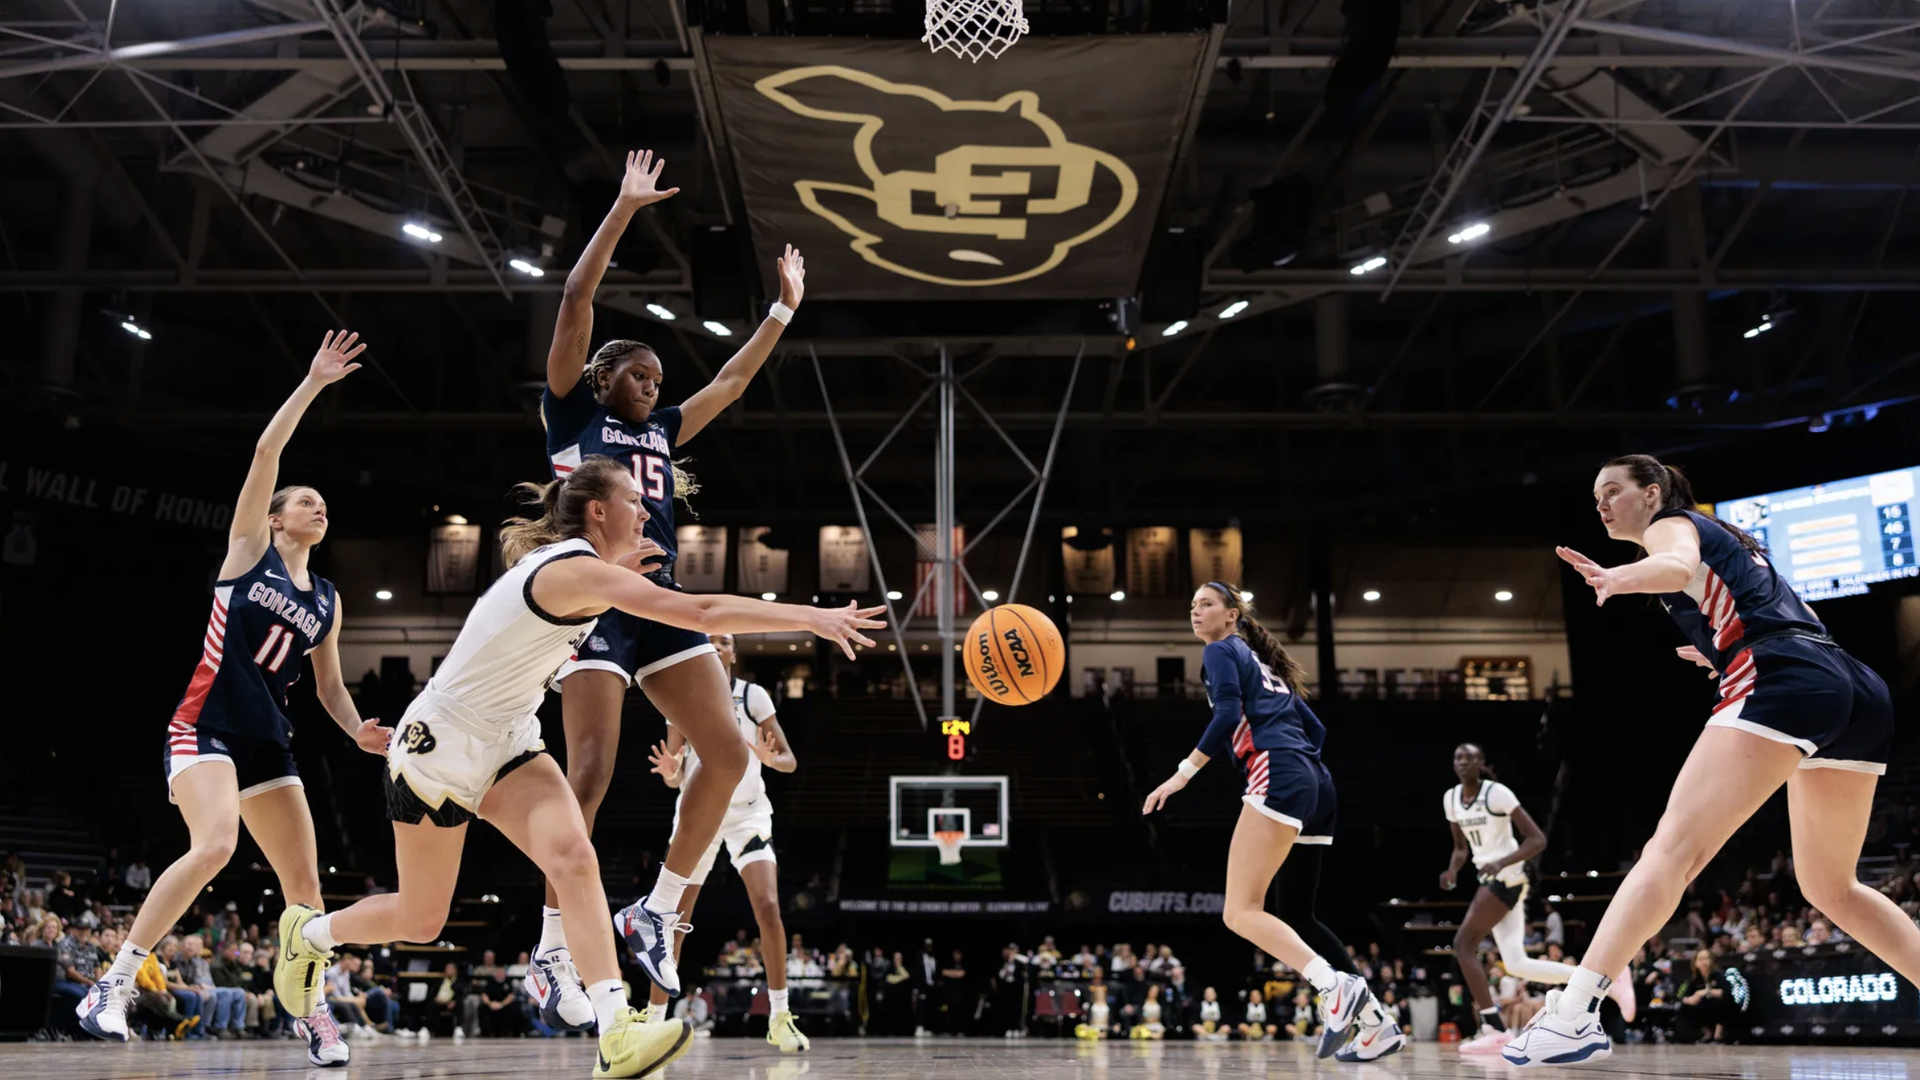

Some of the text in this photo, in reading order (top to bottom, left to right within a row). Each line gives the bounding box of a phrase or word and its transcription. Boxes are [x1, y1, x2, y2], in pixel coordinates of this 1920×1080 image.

[25, 465, 99, 509] WALL
[110, 485, 150, 515] OF
[155, 492, 232, 531] HONO
[631, 453, 665, 501] 15
[247, 581, 322, 643] GONZAGA
[253, 623, 295, 674] 11
[979, 630, 1010, 696] Wilson
[1003, 628, 1035, 678] NCAA
[948, 734, 965, 760] 8
[1780, 973, 1897, 1005] COLORADO
